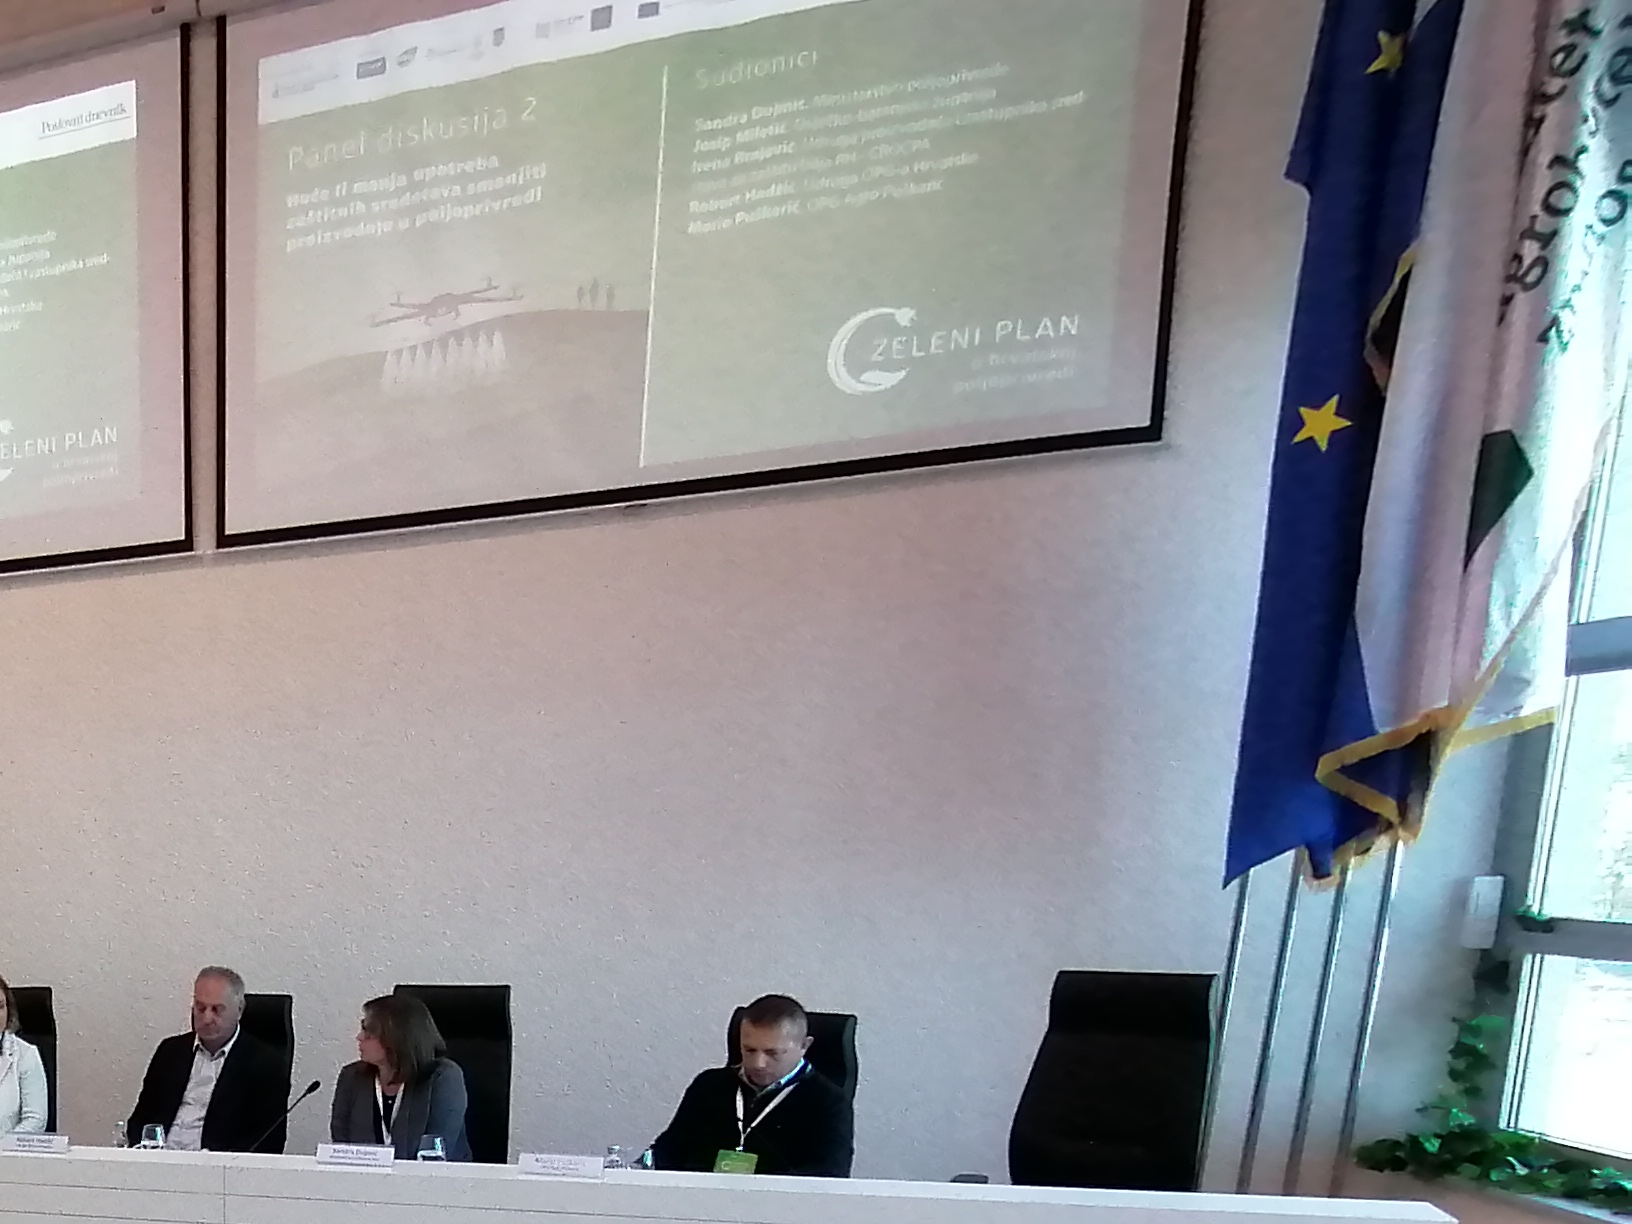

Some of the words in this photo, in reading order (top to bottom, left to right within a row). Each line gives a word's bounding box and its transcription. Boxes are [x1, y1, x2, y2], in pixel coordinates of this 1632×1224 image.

[695, 50, 817, 90] Sudionici
[288, 131, 365, 170] Panel
[377, 106, 507, 155] diskusija
[520, 96, 536, 121] 2
[871, 326, 980, 362] ZELENI
[995, 313, 1080, 343] PLAN
[64, 426, 118, 451] PLAN
